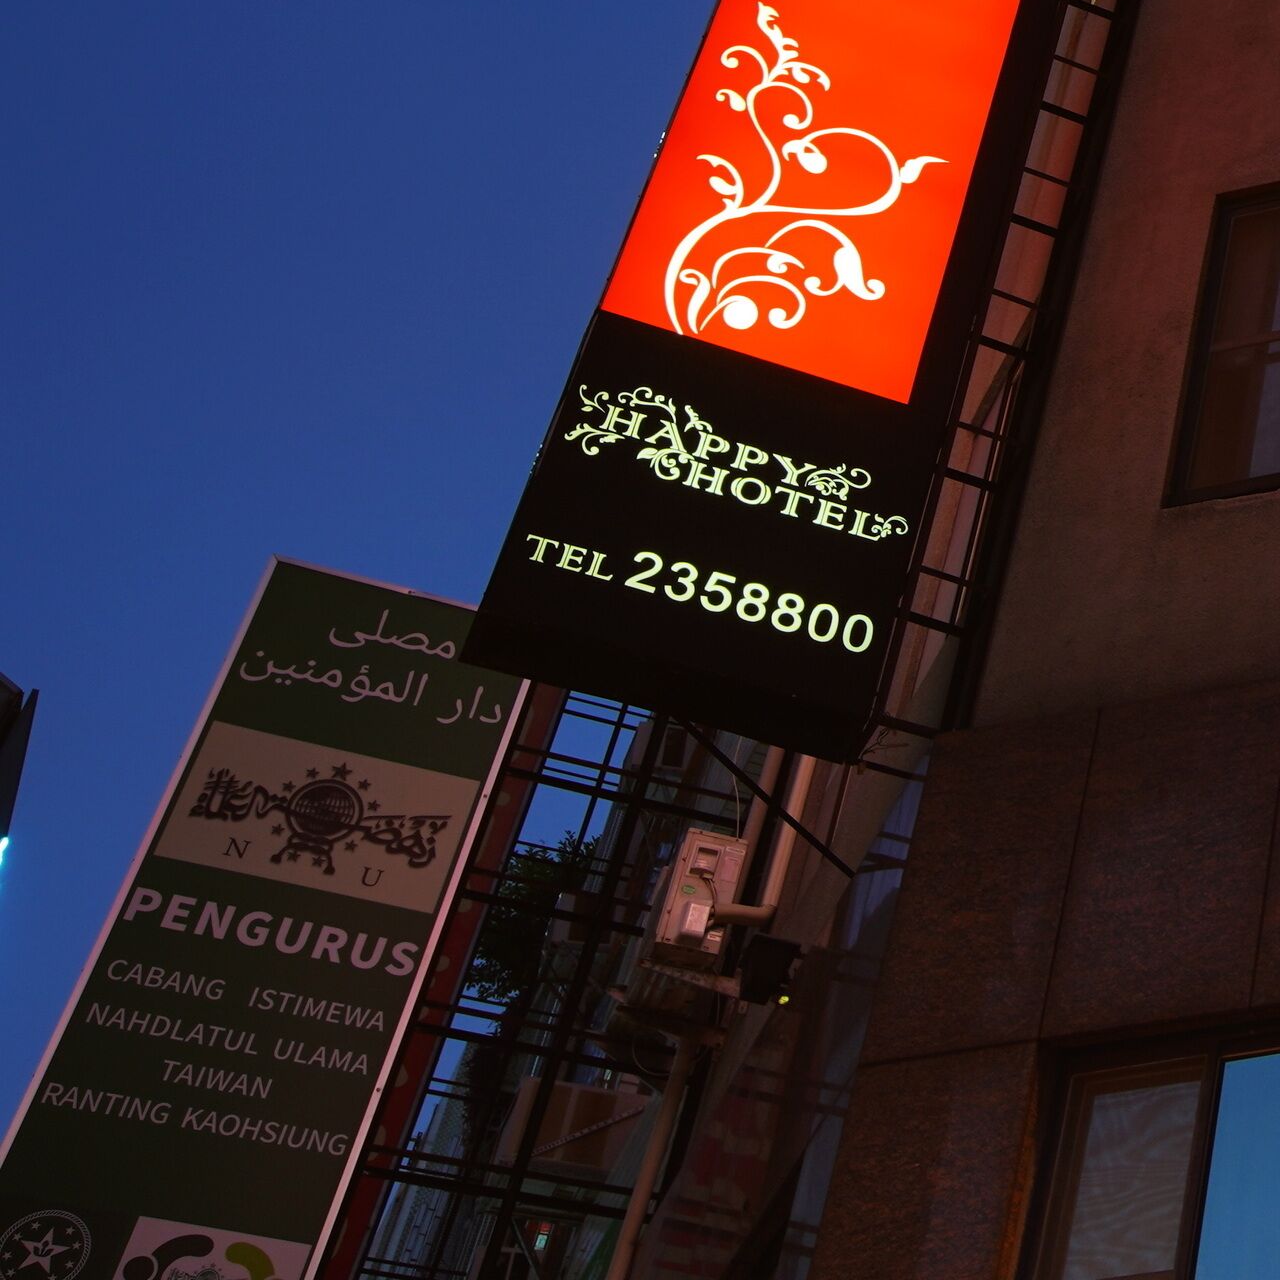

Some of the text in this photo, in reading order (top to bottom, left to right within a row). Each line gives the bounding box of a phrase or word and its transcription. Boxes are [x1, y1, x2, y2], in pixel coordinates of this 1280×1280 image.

[598, 400, 828, 488] HAPPY
[676, 460, 885, 542] HOTEL
[526, 534, 874, 653] TEL 2358800
[328, 609, 457, 660] مصلى
[239, 650, 502, 725] دار المؤمنين
[222, 836, 385, 890] N U
[122, 886, 423, 978] PENGURUS
[107, 958, 386, 1032] CABANG ISTIMEWA
[86, 1002, 370, 1076] NAHDLATUL ULAMA
[161, 1058, 273, 1100] TAIWAN
[41, 1082, 349, 1157] RANTING KAOHSIUNG
